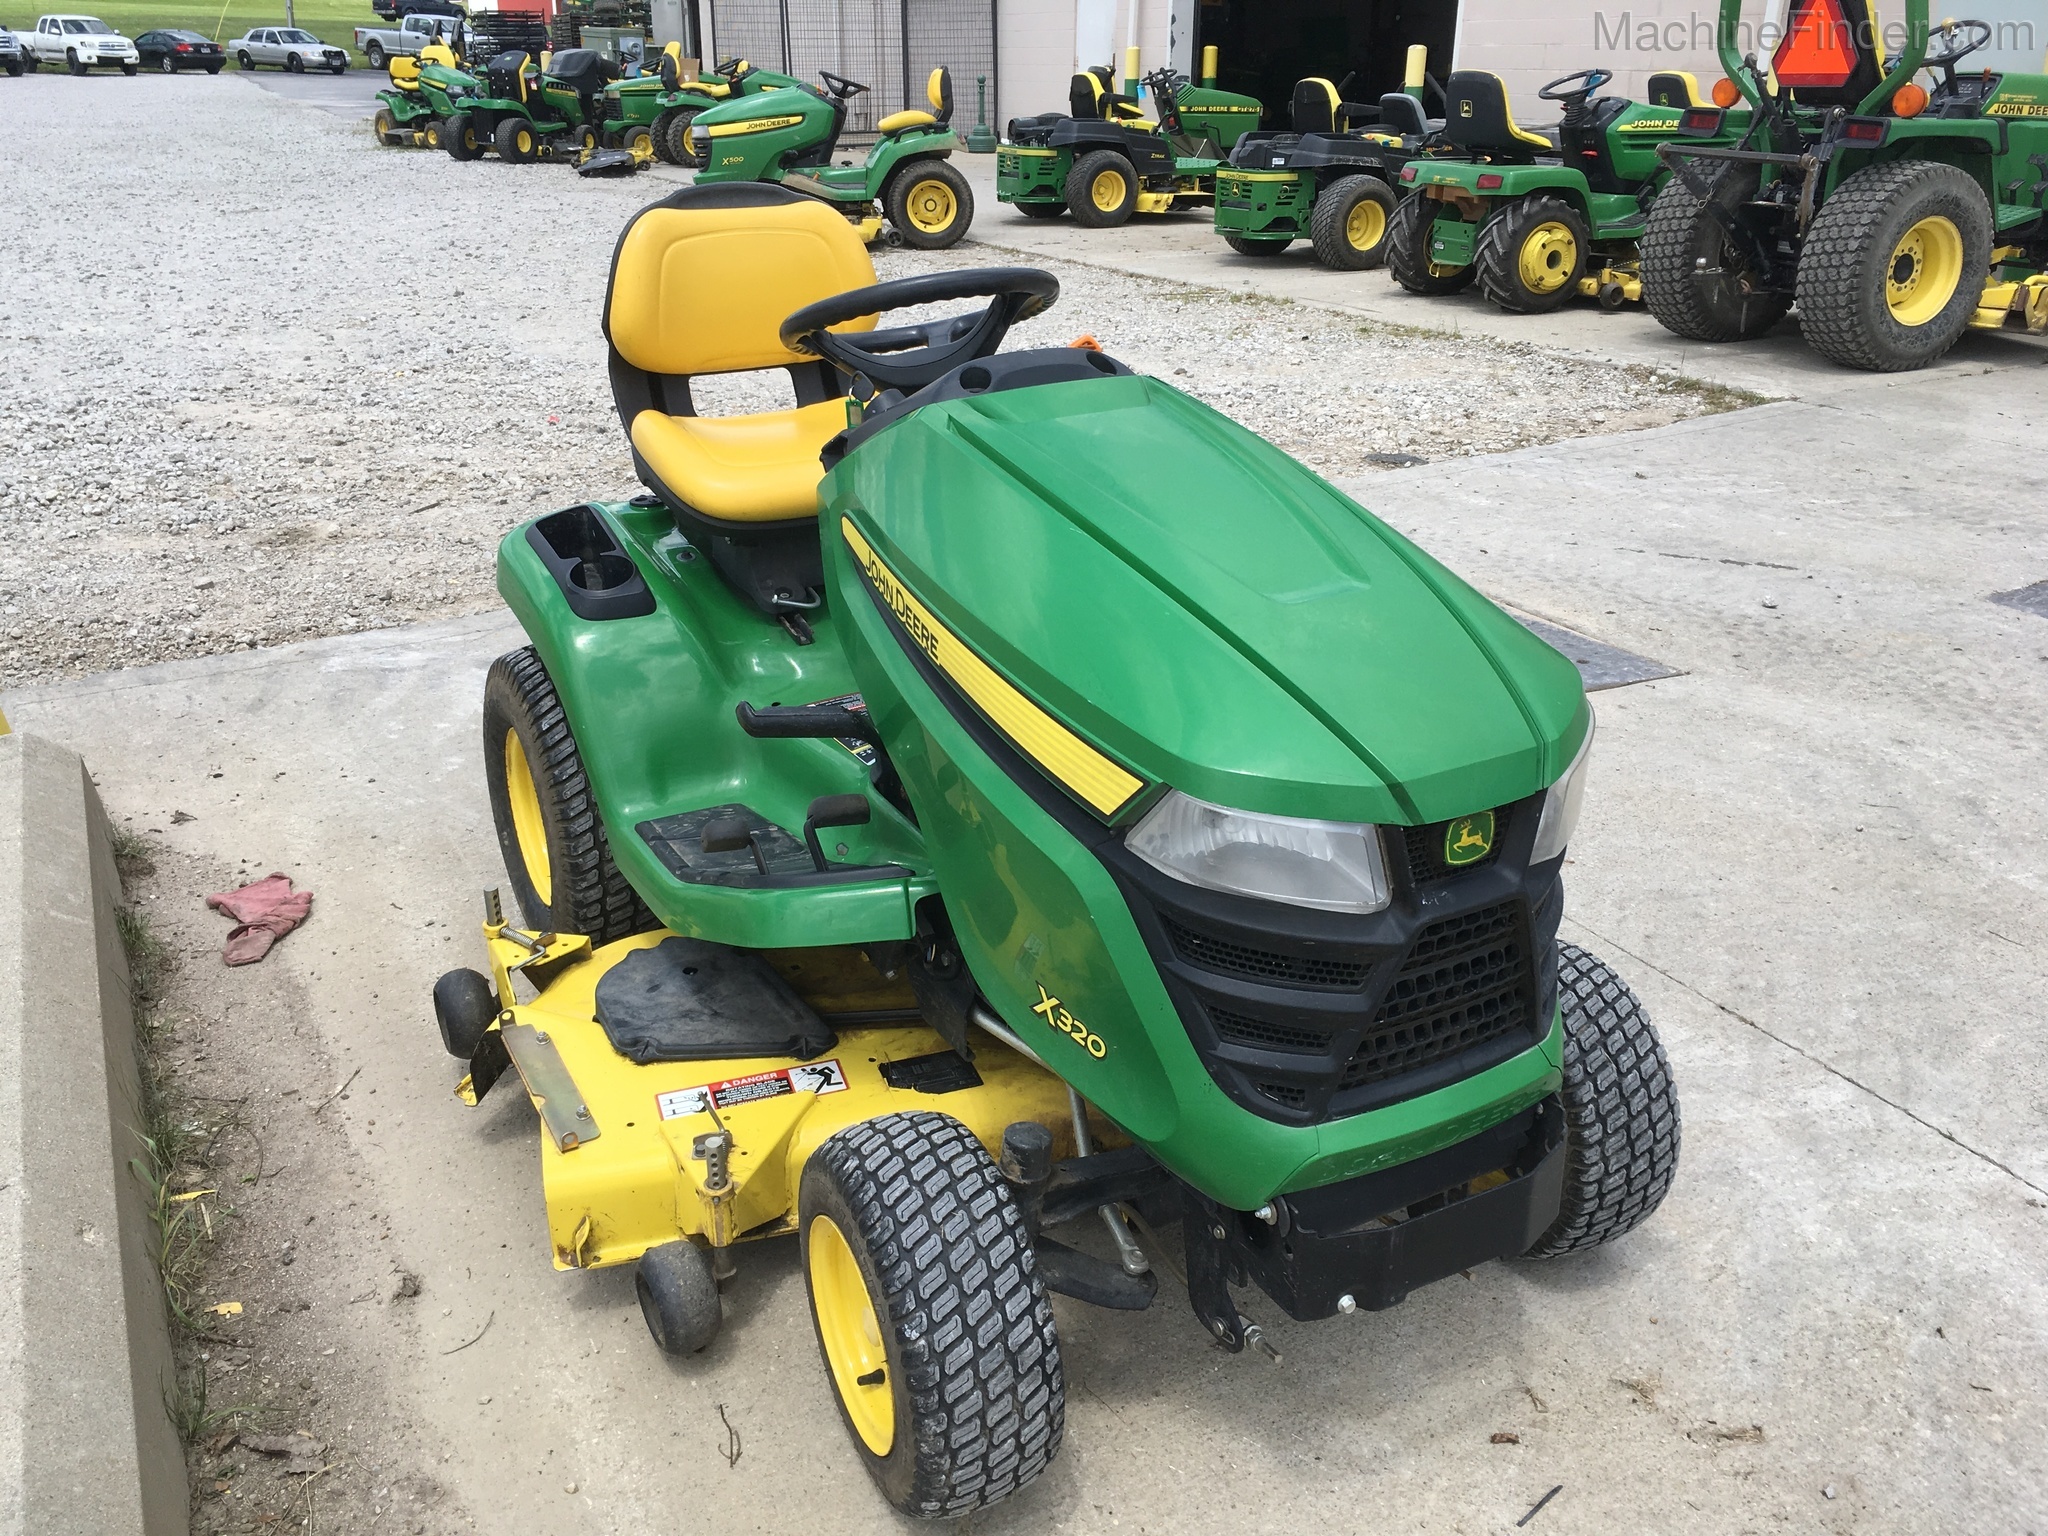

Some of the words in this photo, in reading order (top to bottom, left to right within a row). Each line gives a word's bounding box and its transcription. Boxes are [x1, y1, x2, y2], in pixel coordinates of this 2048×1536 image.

[1994, 104, 2024, 115] JOHN
[746, 122, 766, 130] JOHN
[767, 119, 791, 127] DEERE
[1631, 120, 1661, 128] JOHN
[722, 156, 744, 166] X500
[866, 550, 893, 607] JOHN
[896, 586, 939, 662] DEERE
[1031, 983, 1107, 1059] X320
[732, 1072, 778, 1086] DANGER
